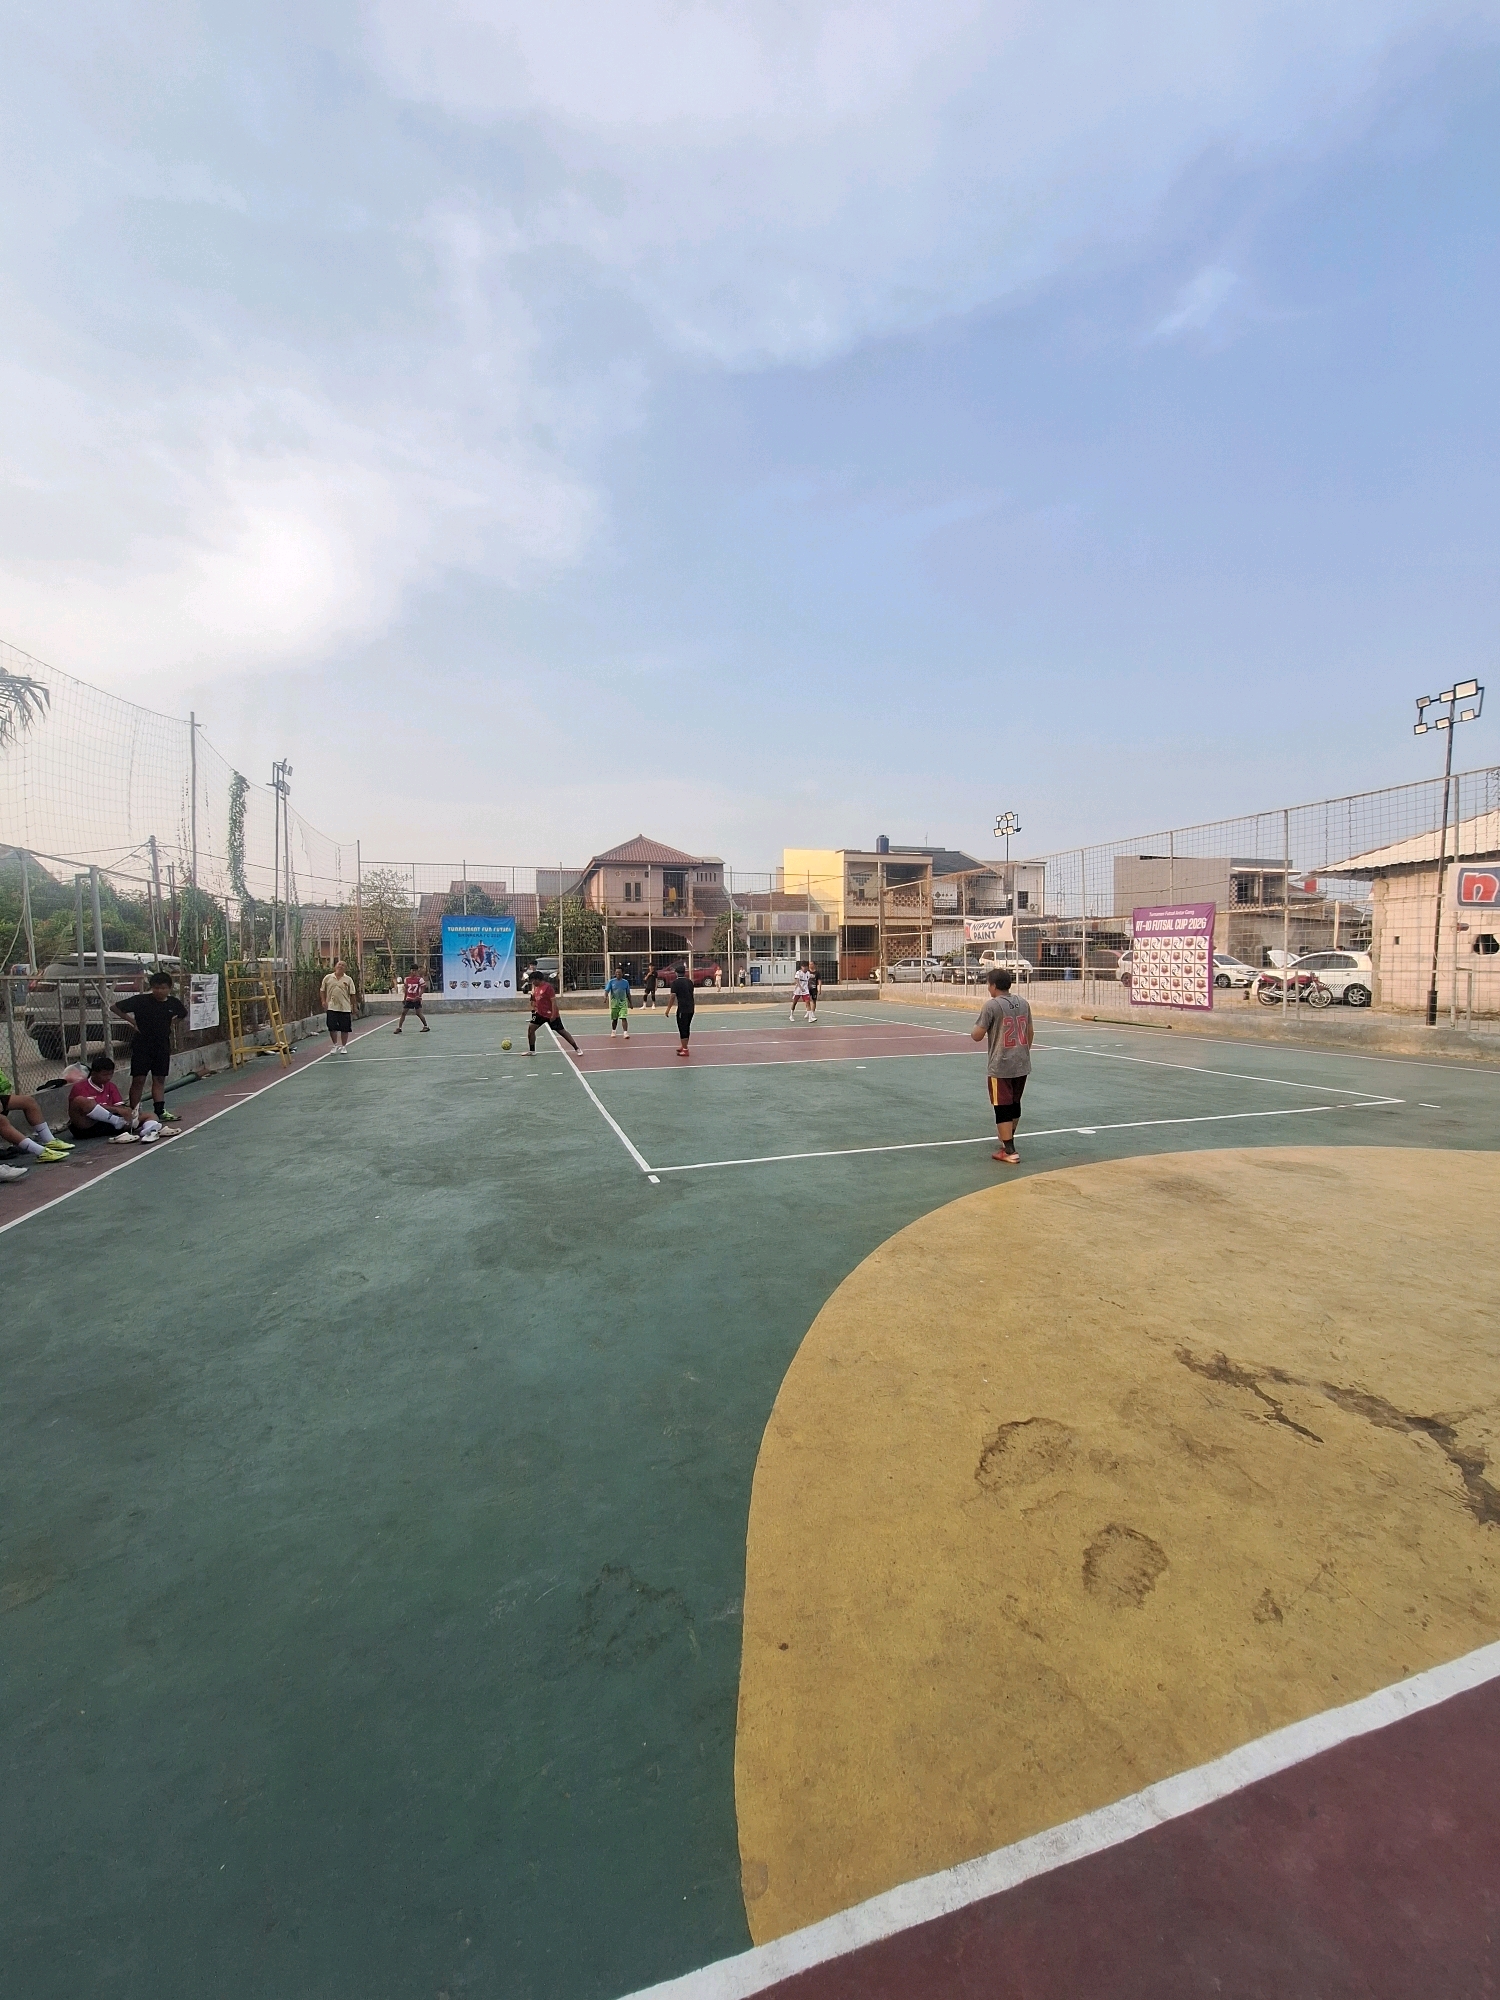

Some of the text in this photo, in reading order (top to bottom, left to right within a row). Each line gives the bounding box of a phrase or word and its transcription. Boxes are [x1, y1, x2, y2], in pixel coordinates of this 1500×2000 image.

[971, 921, 1005, 931] NIPPON
[1136, 918, 1207, 931] RT-10 FUTSAL CUP 2026
[974, 931, 996, 940] PAINT
[407, 983, 419, 993] 27
[1003, 1015, 1028, 1048] 20
